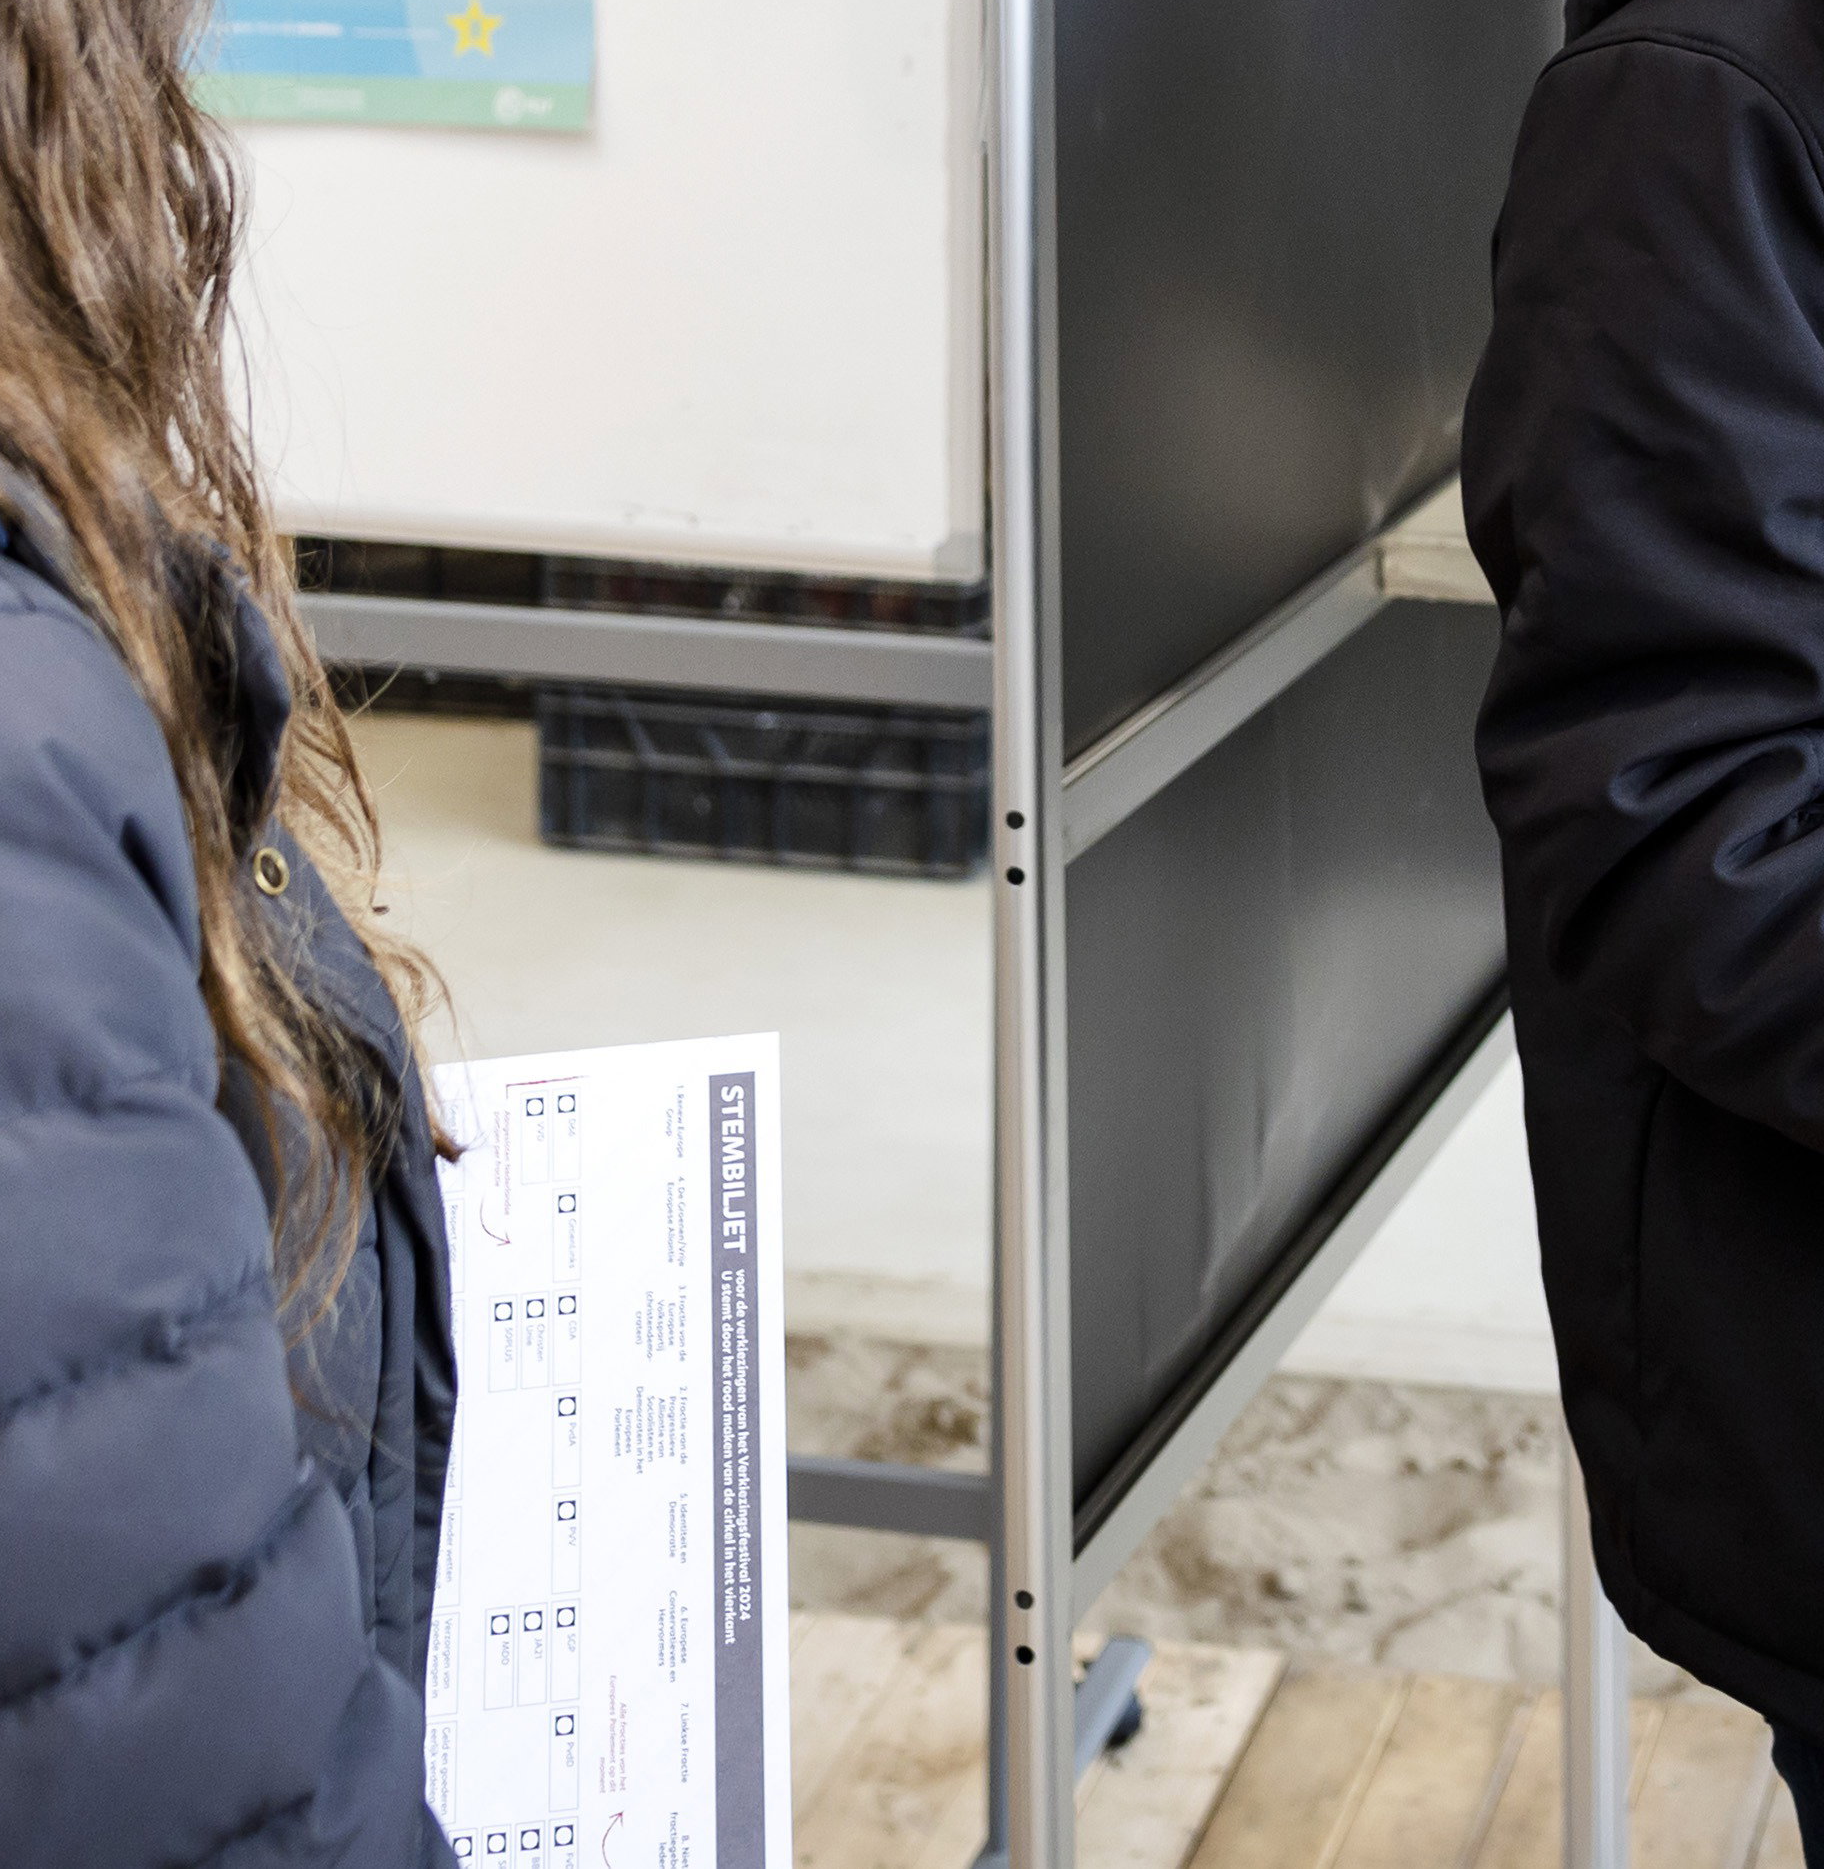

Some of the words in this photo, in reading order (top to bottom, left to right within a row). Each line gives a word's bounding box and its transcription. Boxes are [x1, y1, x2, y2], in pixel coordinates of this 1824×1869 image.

[664, 1108, 674, 1137] Group
[676, 1093, 684, 1124] Renew
[674, 1126, 685, 1159] Europe
[720, 1085, 746, 1253] STEMBILJET
[665, 1182, 676, 1225] Europese
[678, 1187, 686, 1200] De
[567, 1218, 577, 1269] GroenLinks
[722, 1270, 733, 1280] U
[736, 1269, 746, 1299] voor
[678, 1295, 686, 1327] Fractie
[722, 1283, 734, 1321] stemt
[736, 1301, 748, 1317] de
[526, 1325, 534, 1347] Unie
[568, 1320, 576, 1340] CDA
[634, 1311, 644, 1345] craten)
[666, 1303, 676, 1347] Europese
[678, 1329, 686, 1347] van
[722, 1323, 734, 1353] door
[536, 1323, 546, 1362] Christen
[678, 1349, 687, 1361] de
[722, 1355, 734, 1379] het
[734, 1319, 749, 1403] verkiezingen
[722, 1381, 736, 1411] rood
[636, 1386, 645, 1445] Democraten
[646, 1395, 656, 1448] Socialisten
[666, 1396, 677, 1457] Progressieve
[680, 1397, 688, 1431] Fractie
[737, 1404, 748, 1430] van
[614, 1408, 622, 1457] Parlement
[623, 1409, 634, 1454] Europees
[723, 1413, 736, 1459] maken
[738, 1431, 750, 1455] het
[636, 1447, 645, 1456] in
[636, 1458, 645, 1475] het
[646, 1450, 654, 1463] en
[680, 1453, 688, 1465] de
[723, 1461, 734, 1486] van
[724, 1488, 736, 1505] de
[668, 1501, 678, 1558] Democratie
[680, 1503, 688, 1549] Identiteit
[724, 1507, 737, 1545] cirkel
[736, 1455, 752, 1583] Verkiezingsfestival
[568, 1526, 576, 1547] PVV
[680, 1551, 686, 1563] en
[725, 1547, 736, 1560] in
[724, 1562, 737, 1585] het
[724, 1587, 738, 1644] vierkant
[739, 1585, 752, 1621] 2024
[441, 1619, 453, 1669] Verzorgen
[658, 1609, 667, 1667] Hervormers
[668, 1591, 678, 1668] Conservatieven
[678, 1617, 688, 1664] Europese
[442, 1671, 450, 1689] van
[669, 1670, 676, 1683] en
[606, 1675, 617, 1715] Europees
[619, 1702, 628, 1719] Alle
[440, 1727, 450, 1753] Geld
[608, 1718, 618, 1764] Parlement
[619, 1721, 628, 1755] fracties
[681, 1713, 690, 1745] Linkse
[440, 1754, 447, 1765] en
[598, 1757, 606, 1794] moment
[606, 1765, 616, 1779] op
[681, 1747, 690, 1783] Fractie
[436, 1767, 449, 1816] goederen
[609, 1780, 618, 1793] dit
[619, 1776, 628, 1791] het
